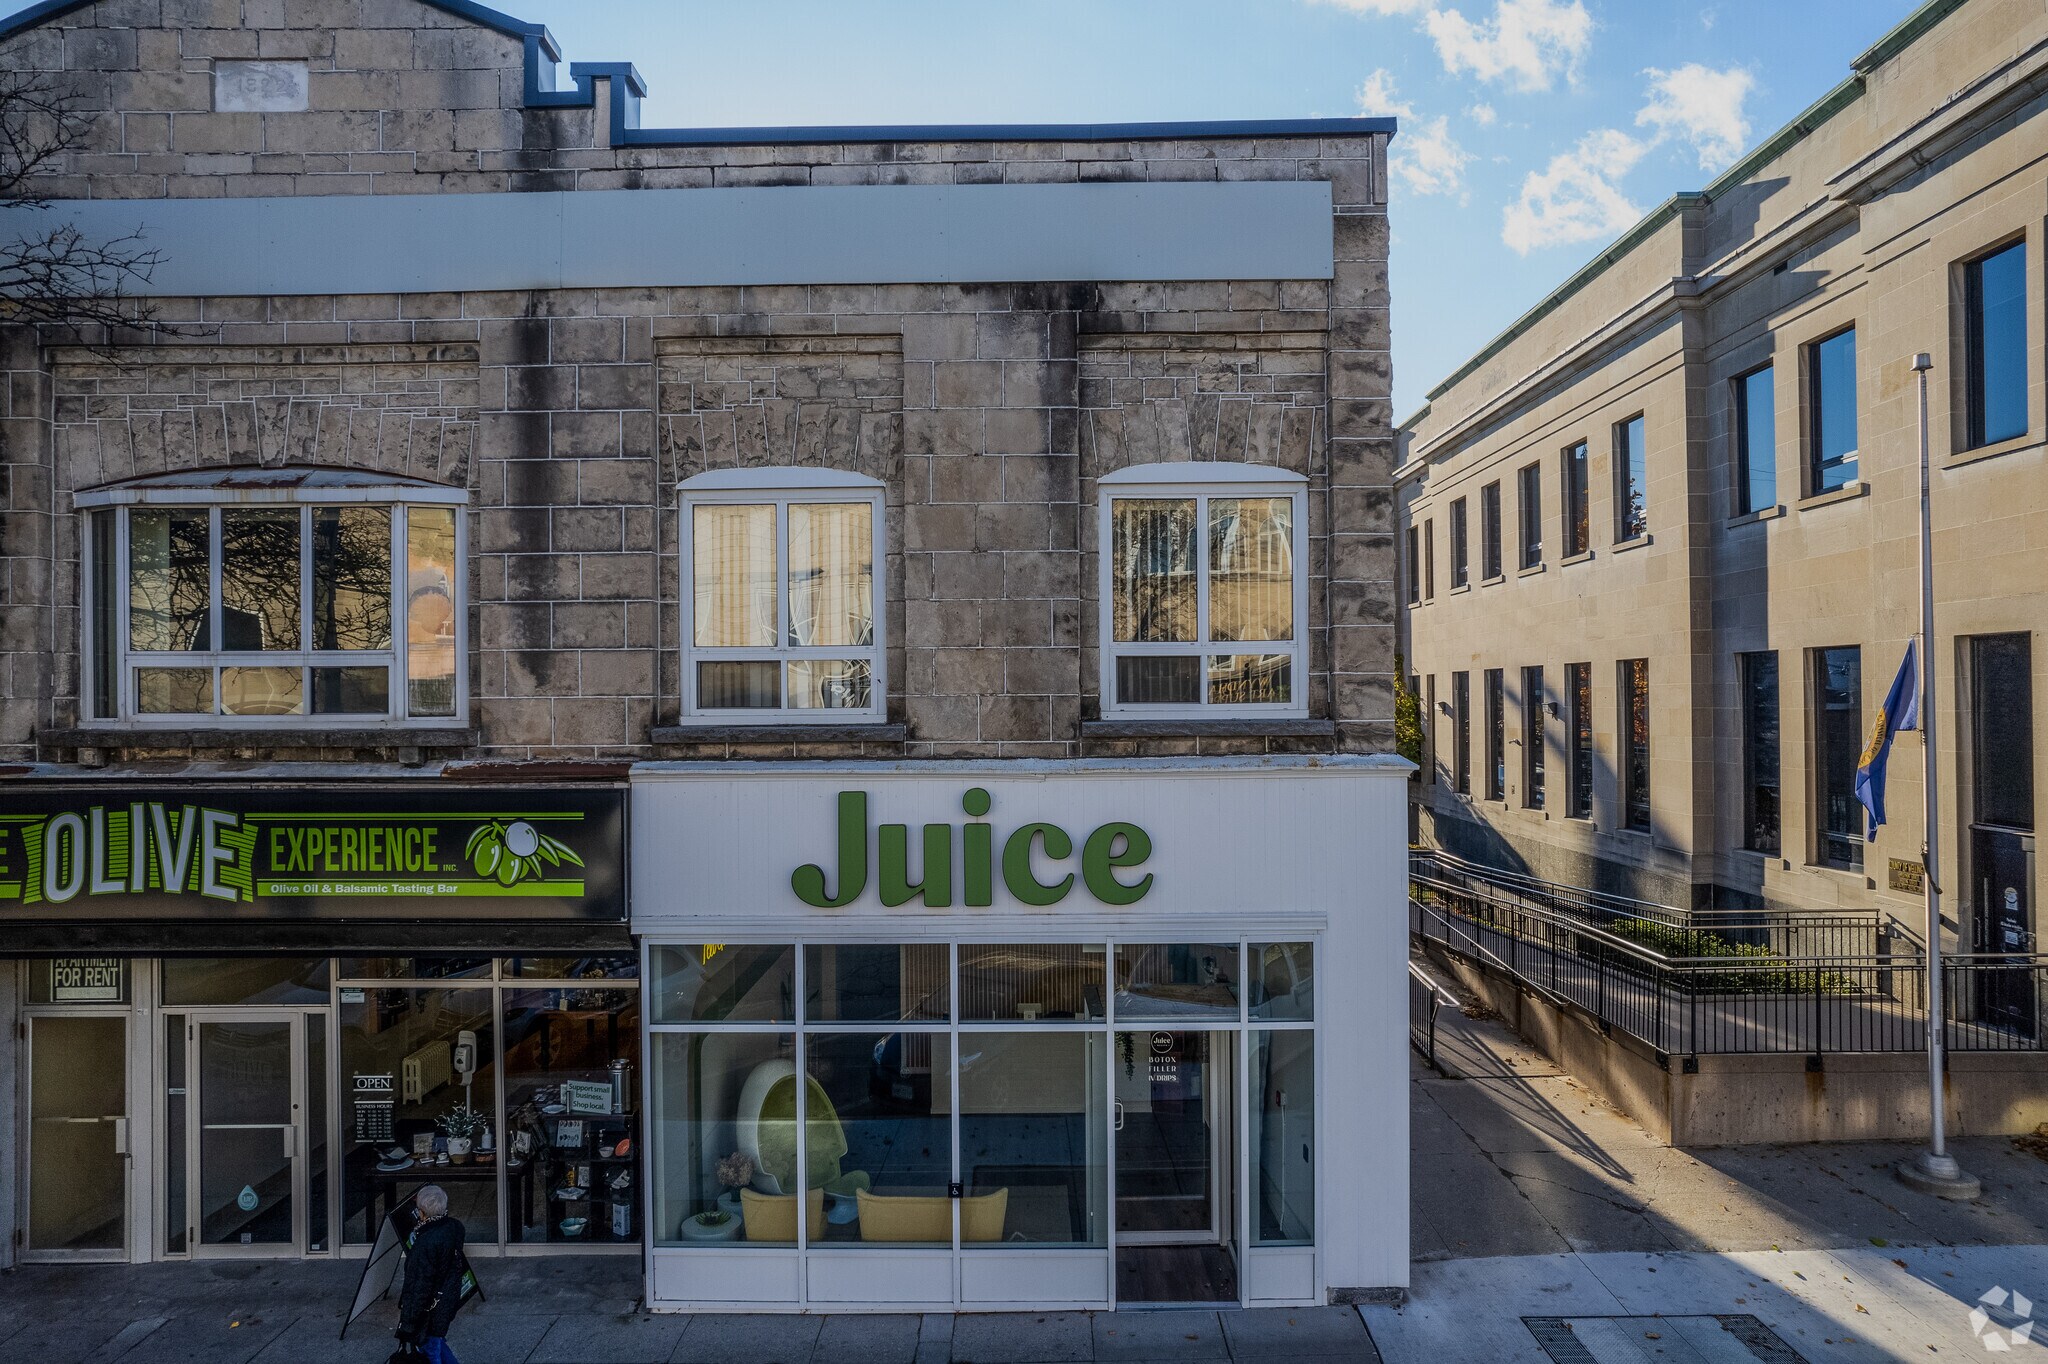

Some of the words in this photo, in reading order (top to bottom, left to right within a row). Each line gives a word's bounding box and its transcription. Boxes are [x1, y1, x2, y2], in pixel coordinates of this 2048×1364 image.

[791, 787, 1154, 907] Juice
[43, 802, 239, 904] OLIVE
[270, 827, 438, 872] EXPERIENCE
[443, 864, 458, 872] INC.
[270, 884, 299, 894] Olive
[303, 884, 318, 894] Oil
[321, 884, 332, 894] &
[335, 884, 388, 894] Balsamic
[391, 884, 434, 895] Tasting
[437, 884, 458, 894] Bar
[55, 967, 81, 987] FOR
[84, 967, 119, 987] RENT
[356, 1078, 390, 1089] OPEN
[568, 1083, 593, 1092] Support
[593, 1086, 610, 1094] small
[575, 1091, 603, 1101] business.
[572, 1101, 589, 1109] Shop
[589, 1102, 605, 1110] local.
